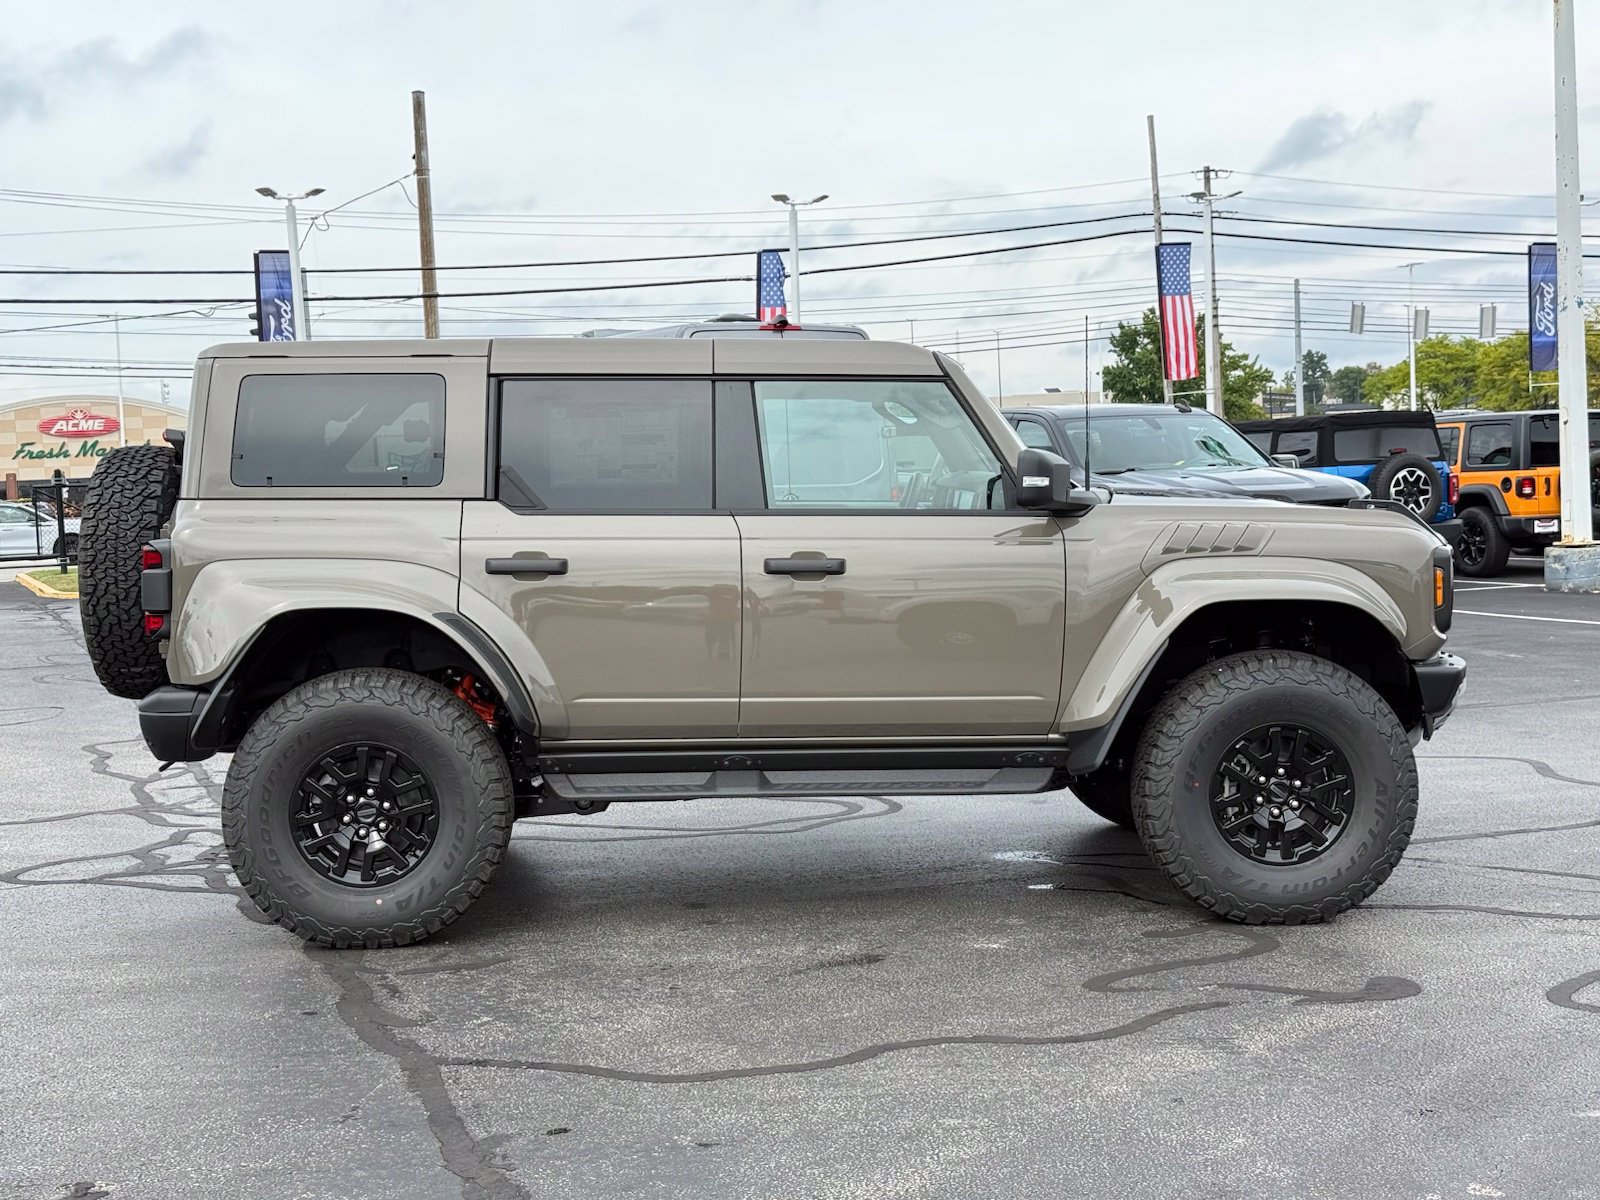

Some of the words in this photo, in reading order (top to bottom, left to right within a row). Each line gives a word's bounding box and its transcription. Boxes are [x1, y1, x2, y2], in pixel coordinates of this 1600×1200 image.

[1535, 282, 1555, 337] Ford
[49, 419, 106, 434] ACME
[12, 441, 70, 460] Fresh
[259, 729, 313, 900] BFGoodrich
[1281, 777, 1388, 895] All-Terrain
[395, 876, 441, 910] T/A
